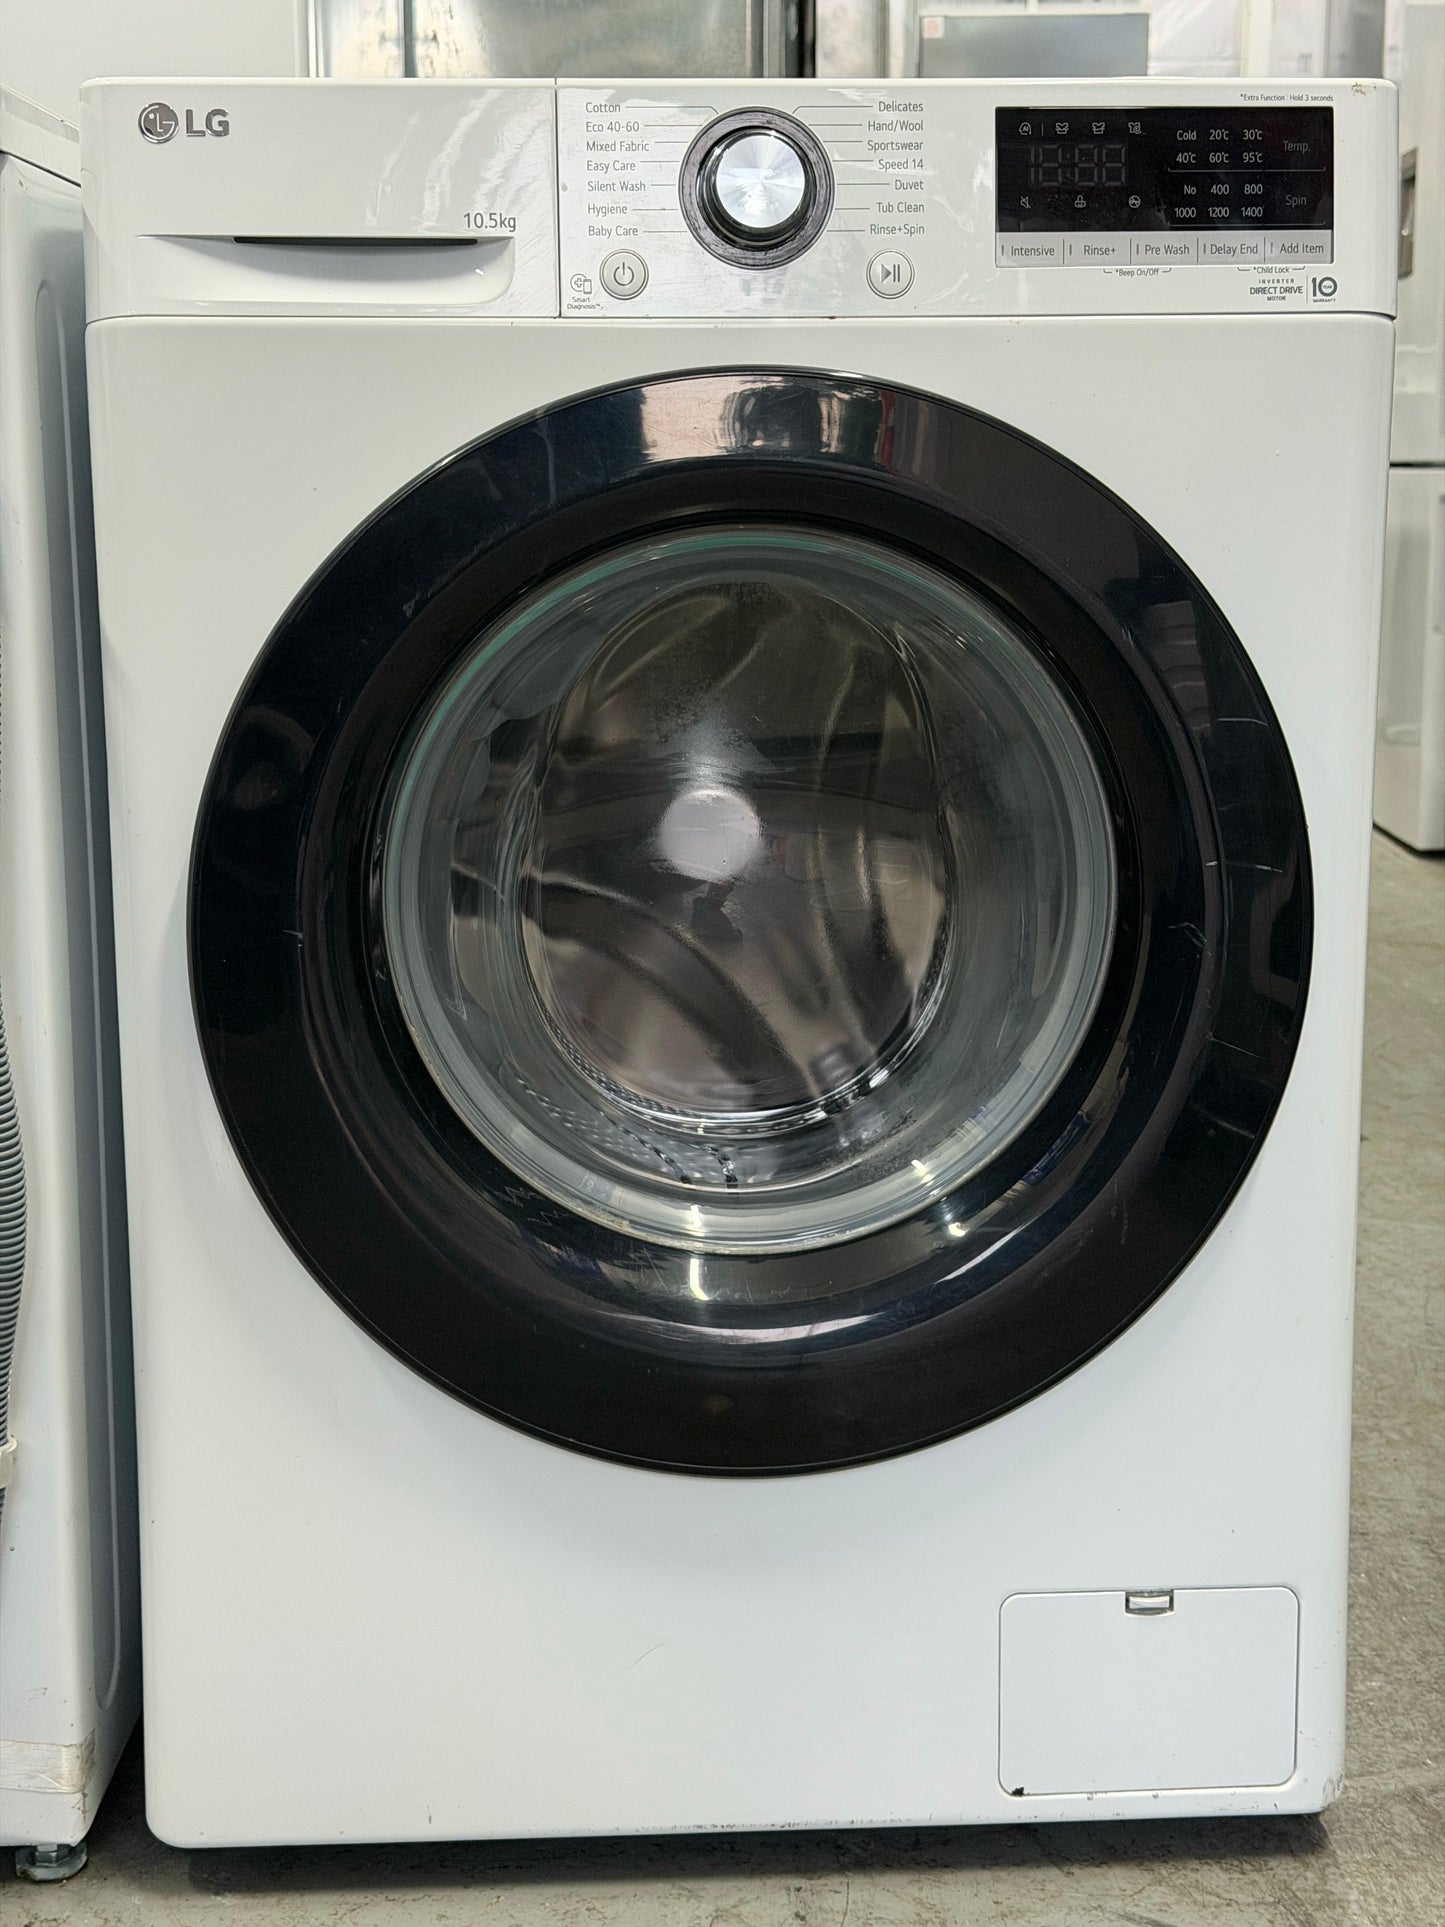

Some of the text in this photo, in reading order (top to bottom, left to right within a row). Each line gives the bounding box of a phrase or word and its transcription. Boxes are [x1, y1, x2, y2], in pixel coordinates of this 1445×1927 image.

[586, 102, 621, 113] Cotton
[879, 101, 924, 112] Delicates
[186, 108, 230, 137] LG
[586, 121, 639, 132] Eco 40-60
[868, 120, 924, 132] Hand/Wool
[1177, 130, 1197, 141] Cold
[586, 141, 649, 152] Mixed Fabric
[868, 140, 924, 153] Sportswear
[1283, 141, 1311, 154] Temp.
[587, 160, 635, 174] Easy Care
[879, 159, 924, 172] Speed 14
[587, 181, 646, 192] Silent Wash
[895, 180, 924, 190] Duvet
[1184, 185, 1197, 195] No
[1211, 184, 1229, 195] 400
[1244, 184, 1263, 195] 800
[1286, 195, 1307, 208] Spin
[587, 204, 628, 217] Hygiene
[876, 202, 925, 213] Tub Clean
[1175, 207, 1197, 218] 1000
[1208, 207, 1229, 218] 1200
[1241, 207, 1263, 217] 1400
[463, 212, 517, 232] 10.5kg
[588, 225, 638, 239] Baby Care
[870, 223, 925, 237] Rinse+Spin
[1011, 244, 1055, 256] Intensive
[1084, 244, 1116, 256] Rinse+
[1145, 244, 1190, 255] Pre Wash
[1210, 243, 1258, 257] Delay End
[1280, 243, 1324, 254] Add Item
[1137, 268, 1159, 276] On/Off
[1250, 286, 1303, 295] DIRECT DRIVE
[1311, 276, 1338, 297] 10
